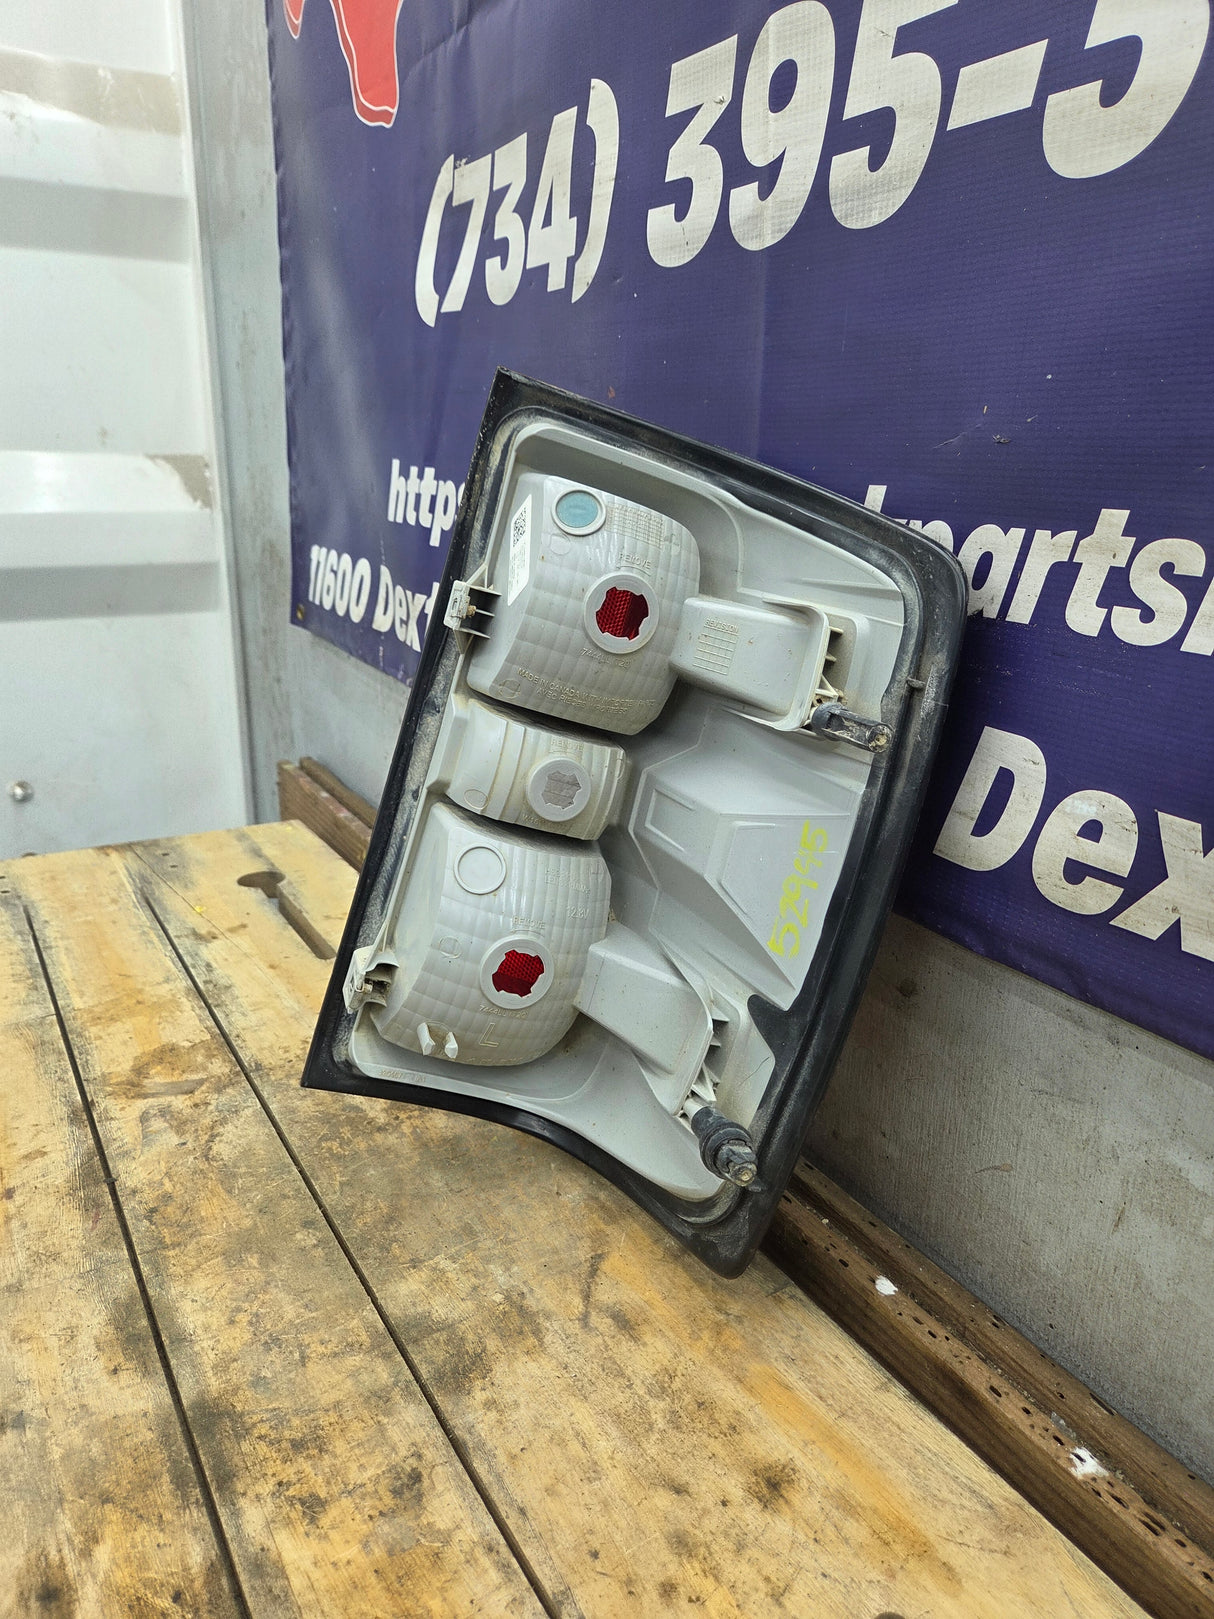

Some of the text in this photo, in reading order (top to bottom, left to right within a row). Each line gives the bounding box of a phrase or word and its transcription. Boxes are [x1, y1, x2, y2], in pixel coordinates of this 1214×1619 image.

[414, 0, 1211, 328] (734) 395-5
[619, 551, 652, 571] REMOVE
[308, 544, 372, 623] 11600
[517, 667, 540, 684] MADE
[540, 678, 550, 689] IN
[549, 682, 581, 698] CANADA
[766, 819, 829, 960] 52945
[511, 915, 547, 930] REMOVE
[478, 1021, 500, 1048] L
